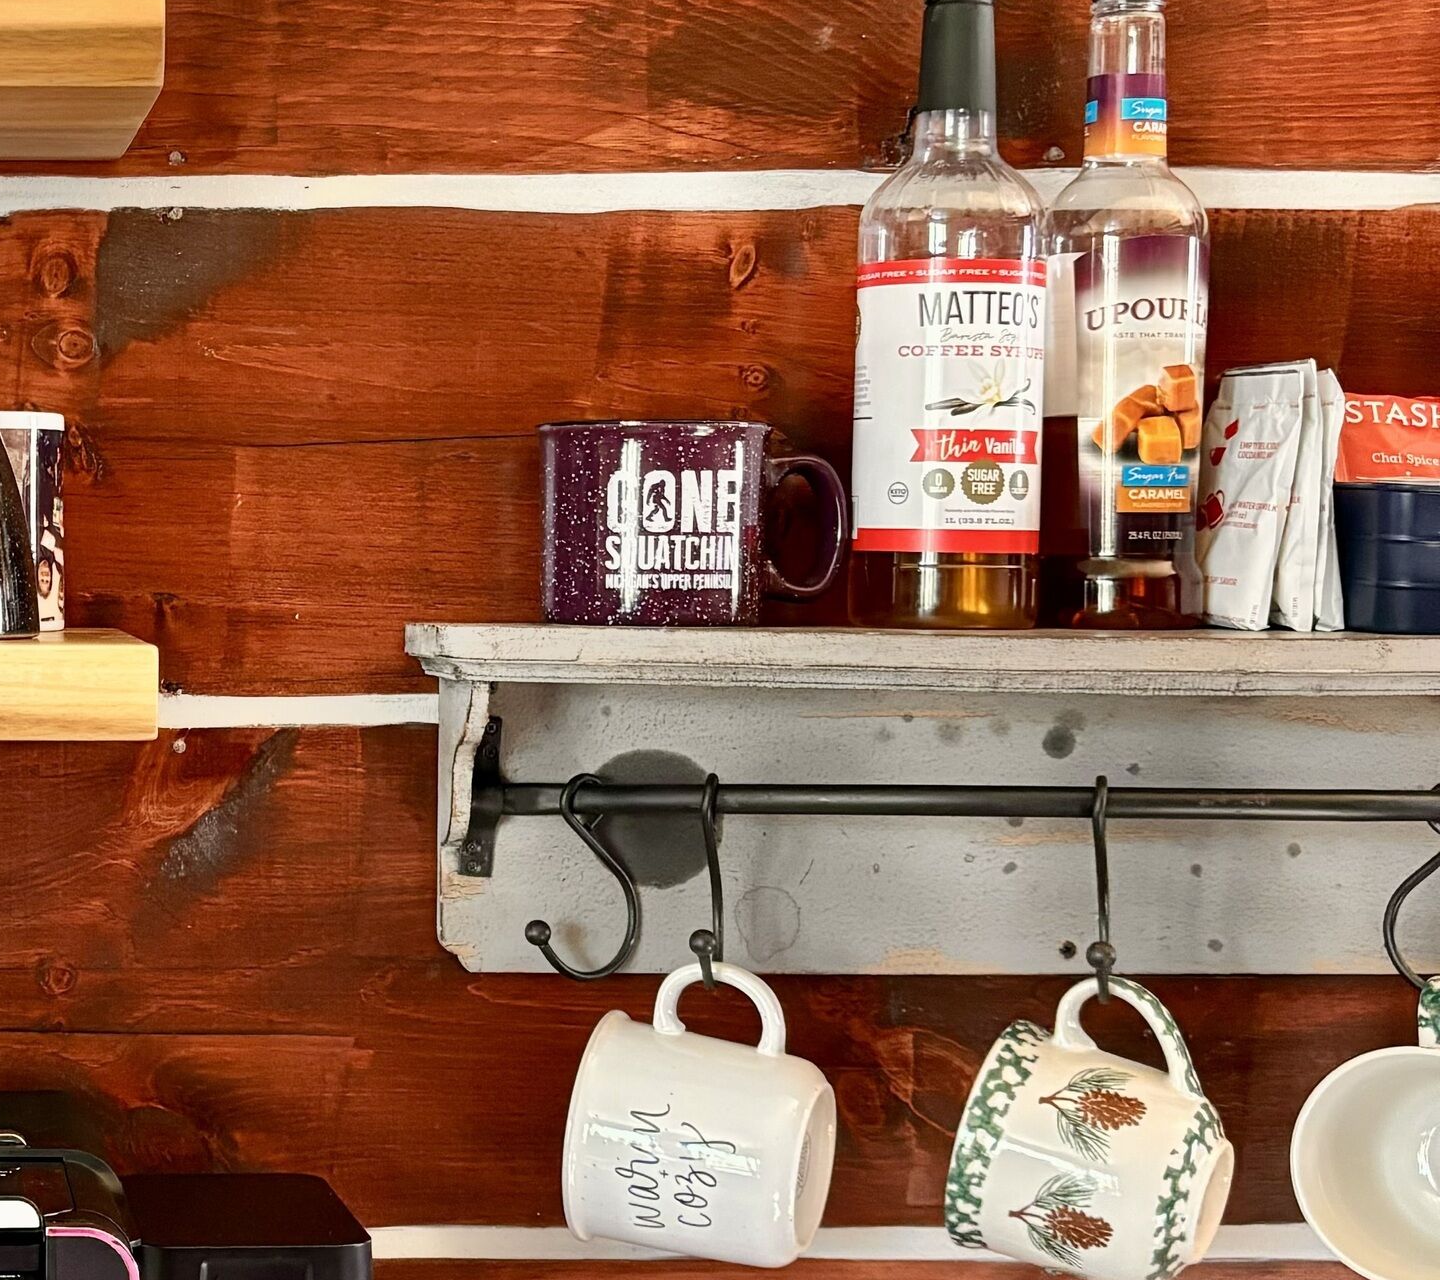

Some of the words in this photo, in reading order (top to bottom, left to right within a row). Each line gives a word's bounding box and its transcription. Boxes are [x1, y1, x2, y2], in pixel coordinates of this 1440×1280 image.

[881, 270, 907, 279] FREE
[915, 269, 958, 277] SUGAR
[918, 290, 1039, 329] MATTEO'S
[898, 345, 984, 357] COFFEE
[936, 429, 982, 461] thin
[984, 437, 1026, 455] Vanila
[1372, 452, 1403, 464] Chai
[1406, 453, 1440, 467] Spice
[967, 469, 1000, 482] SUGAR
[971, 482, 996, 495] FREE
[1128, 489, 1186, 500] CARAMEL
